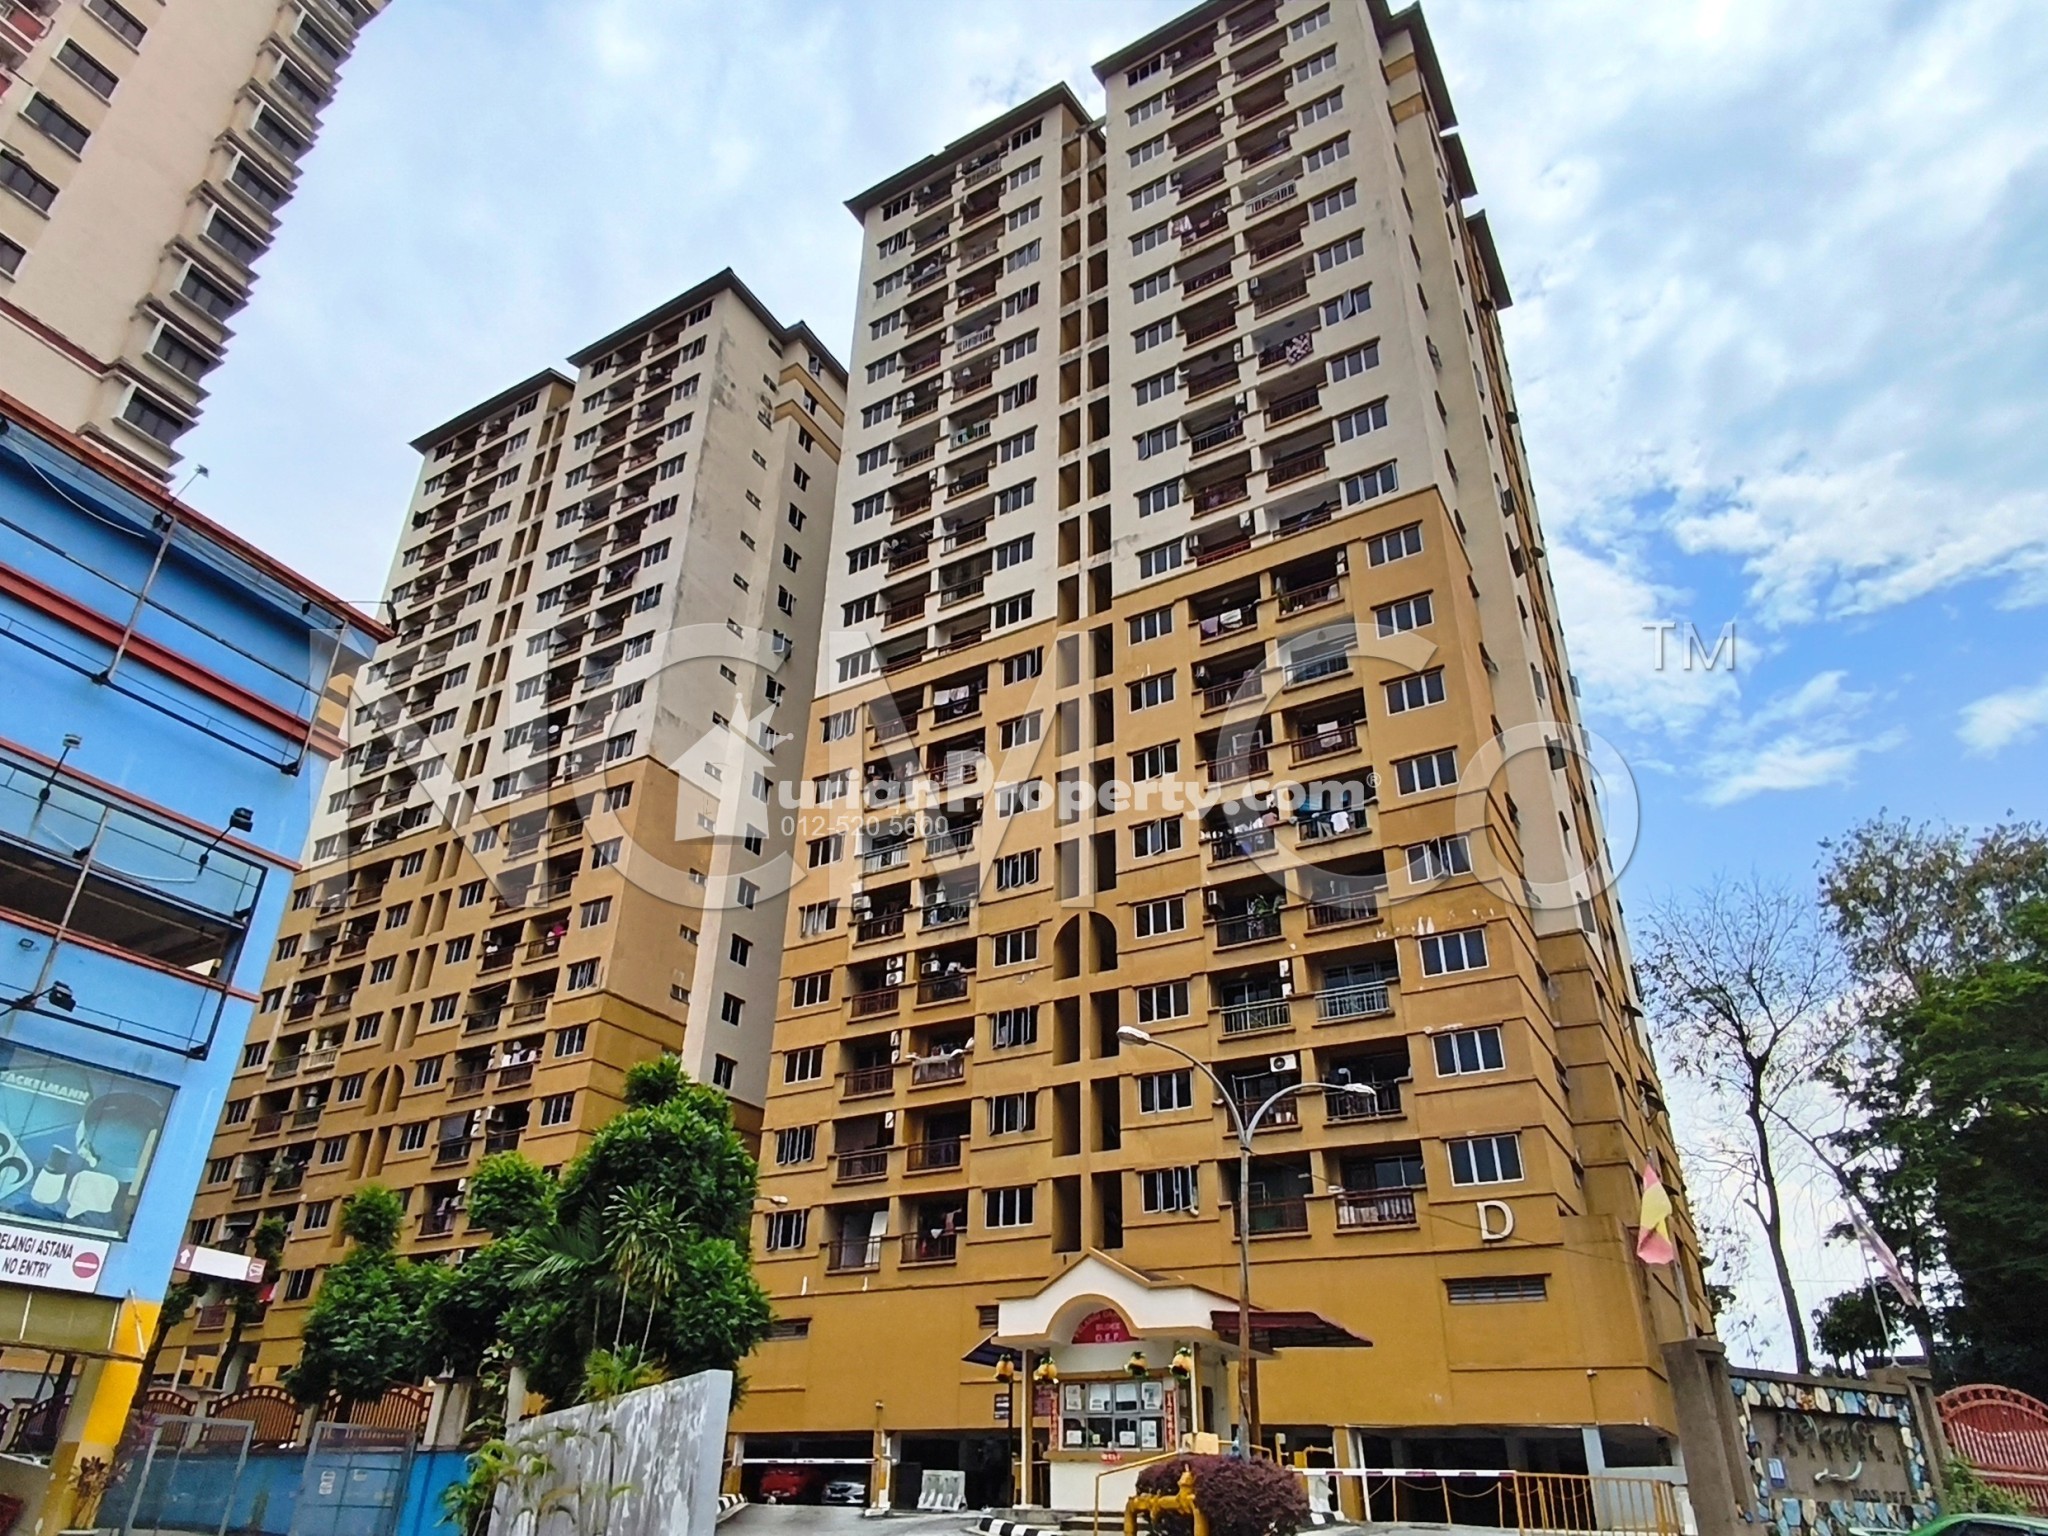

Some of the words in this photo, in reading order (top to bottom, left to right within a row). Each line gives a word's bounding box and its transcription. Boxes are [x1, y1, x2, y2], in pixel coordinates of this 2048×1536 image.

[1476, 1200, 1514, 1240] D
[36, 1240, 74, 1259] ASTANA
[1, 1257, 19, 1275] NO
[18, 1259, 52, 1279] ENTRY
